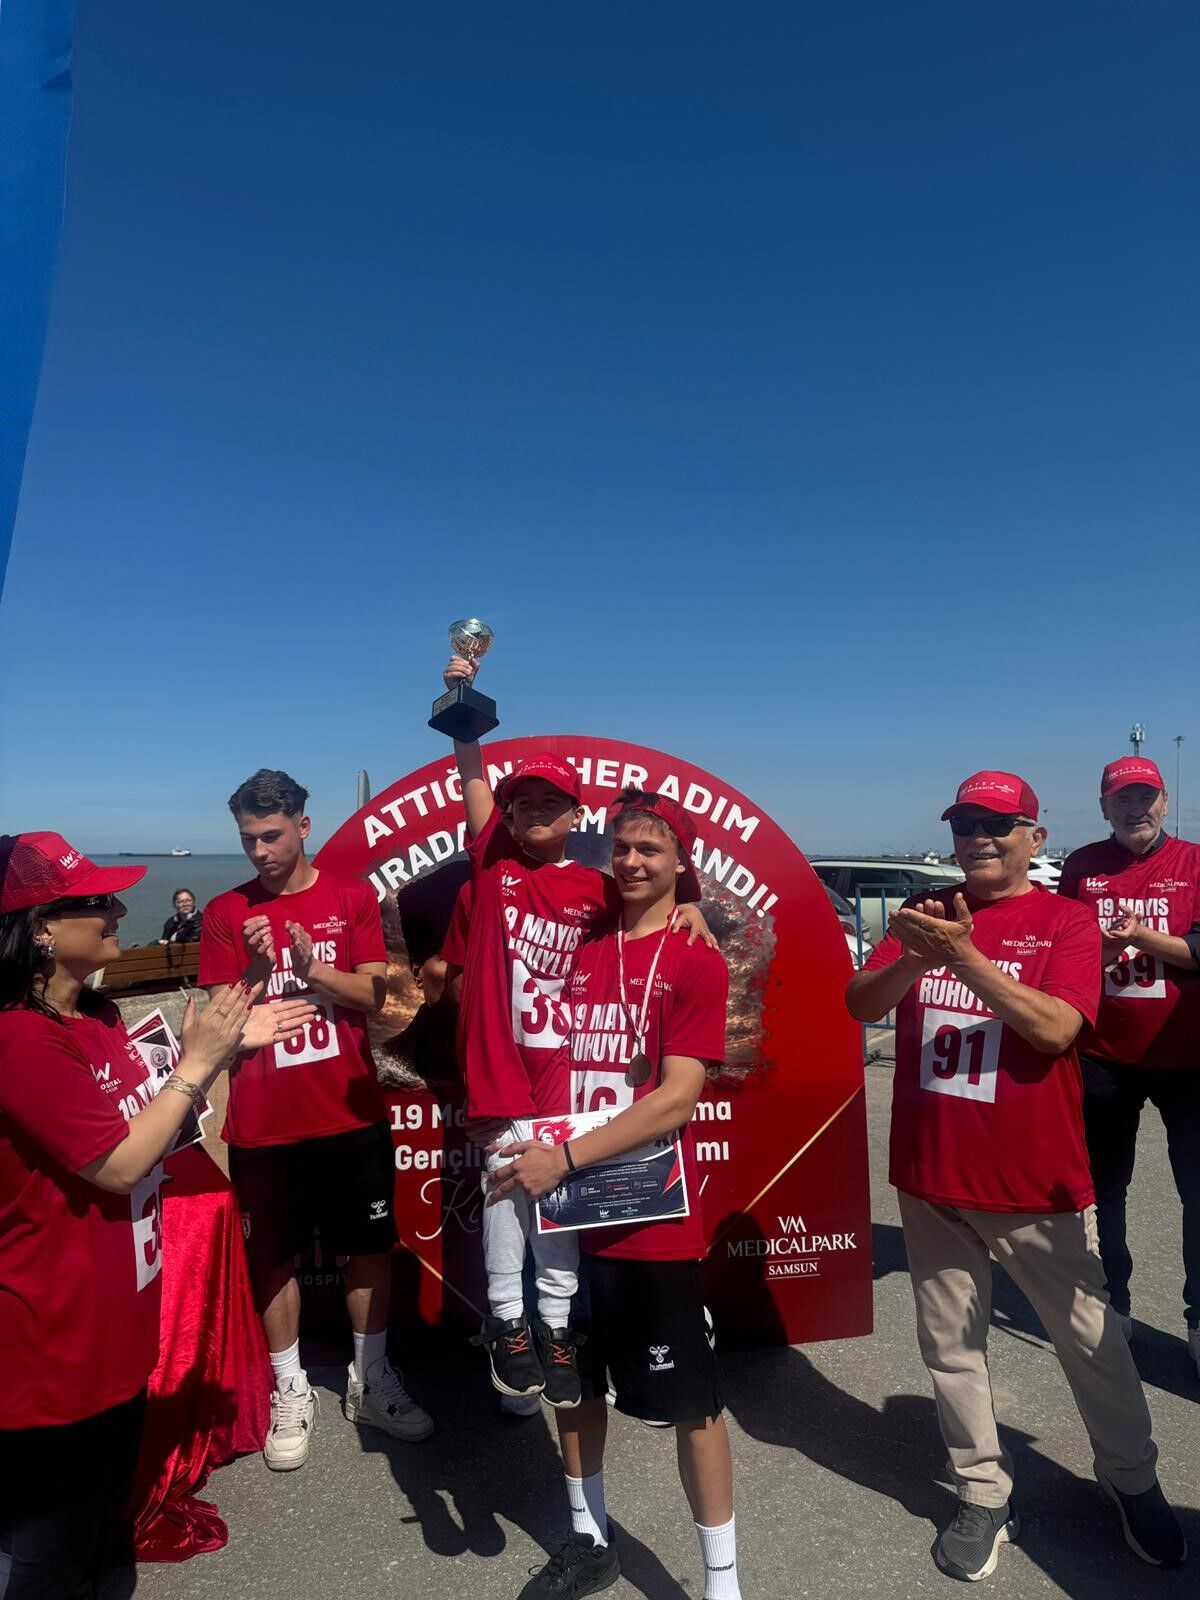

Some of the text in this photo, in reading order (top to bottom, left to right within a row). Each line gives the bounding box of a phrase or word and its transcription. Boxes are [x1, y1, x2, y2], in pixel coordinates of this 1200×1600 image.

[567, 755, 648, 791] HER
[656, 775, 760, 843] ADIM
[1096, 897, 1169, 917] 19 MAYIS
[519, 912, 582, 952] MAYIS
[932, 1024, 986, 1086] 91
[390, 1104, 423, 1130] 19
[395, 1142, 480, 1175] Gençli
[778, 1216, 807, 1234] VM
[727, 1232, 857, 1258] MEDICALPARK
[768, 1261, 818, 1276] SAMSUN
[649, 1360, 674, 1371] hummel
